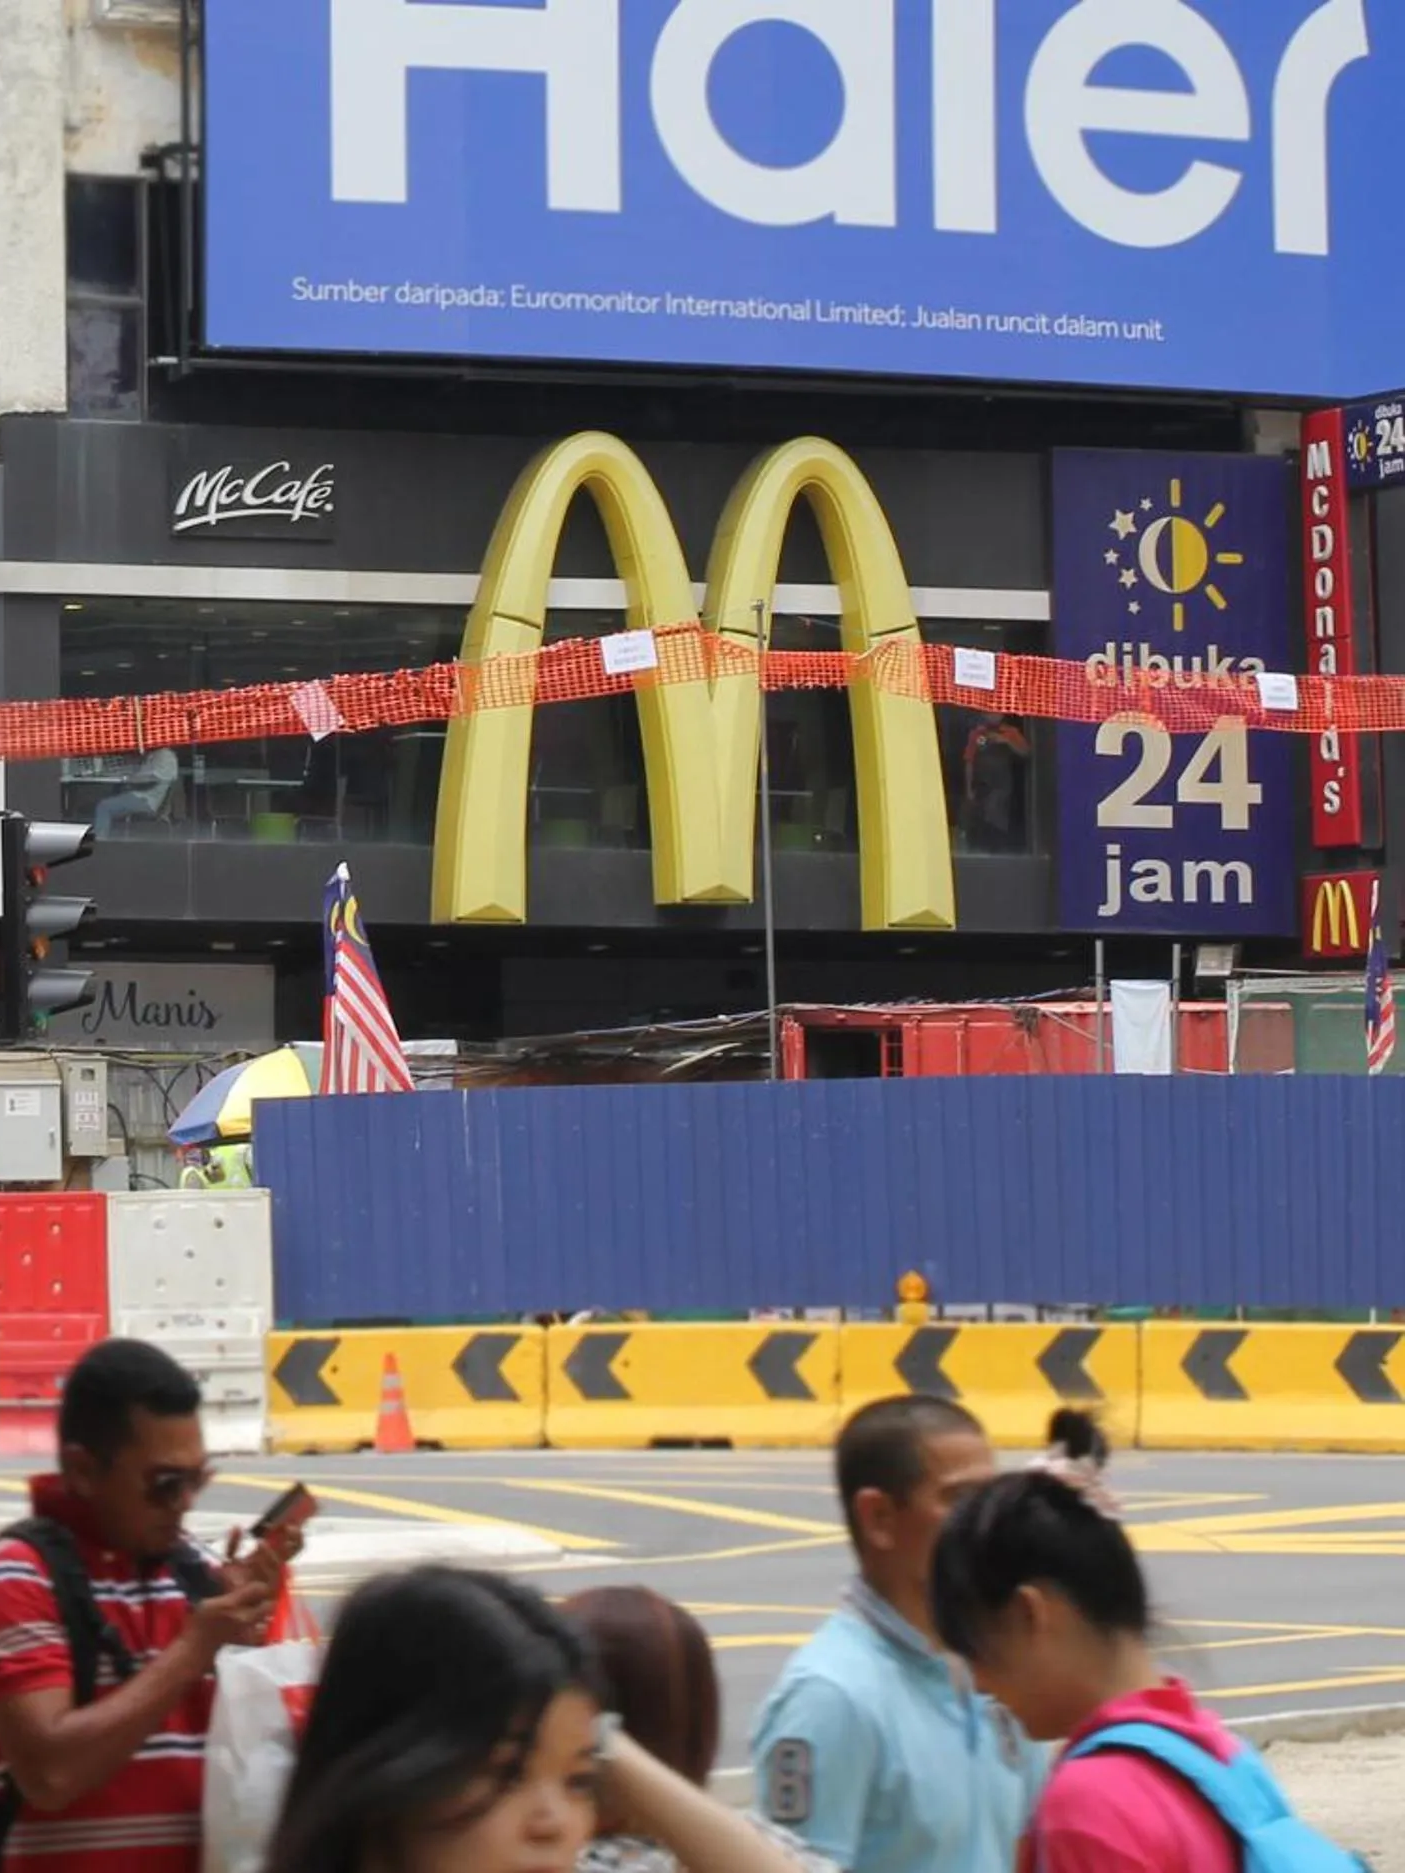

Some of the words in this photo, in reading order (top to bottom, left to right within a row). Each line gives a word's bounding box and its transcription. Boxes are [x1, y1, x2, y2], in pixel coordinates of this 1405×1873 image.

[330, 0, 1369, 256] Haier
[292, 276, 389, 302] Sumber
[394, 281, 506, 310] daripada:
[511, 285, 661, 315] Euromonitor
[665, 292, 812, 322] International
[911, 305, 982, 332] Jualan
[986, 311, 1050, 335] runcit
[1053, 314, 1120, 340] dalam
[1123, 320, 1165, 342] unit
[1376, 416, 1405, 456] 24
[1379, 457, 1405, 480] jam
[1085, 641, 1266, 690] dibuka
[1095, 711, 1263, 830] 24
[1098, 844, 1253, 917] jam
[81, 980, 222, 1036] Manis
